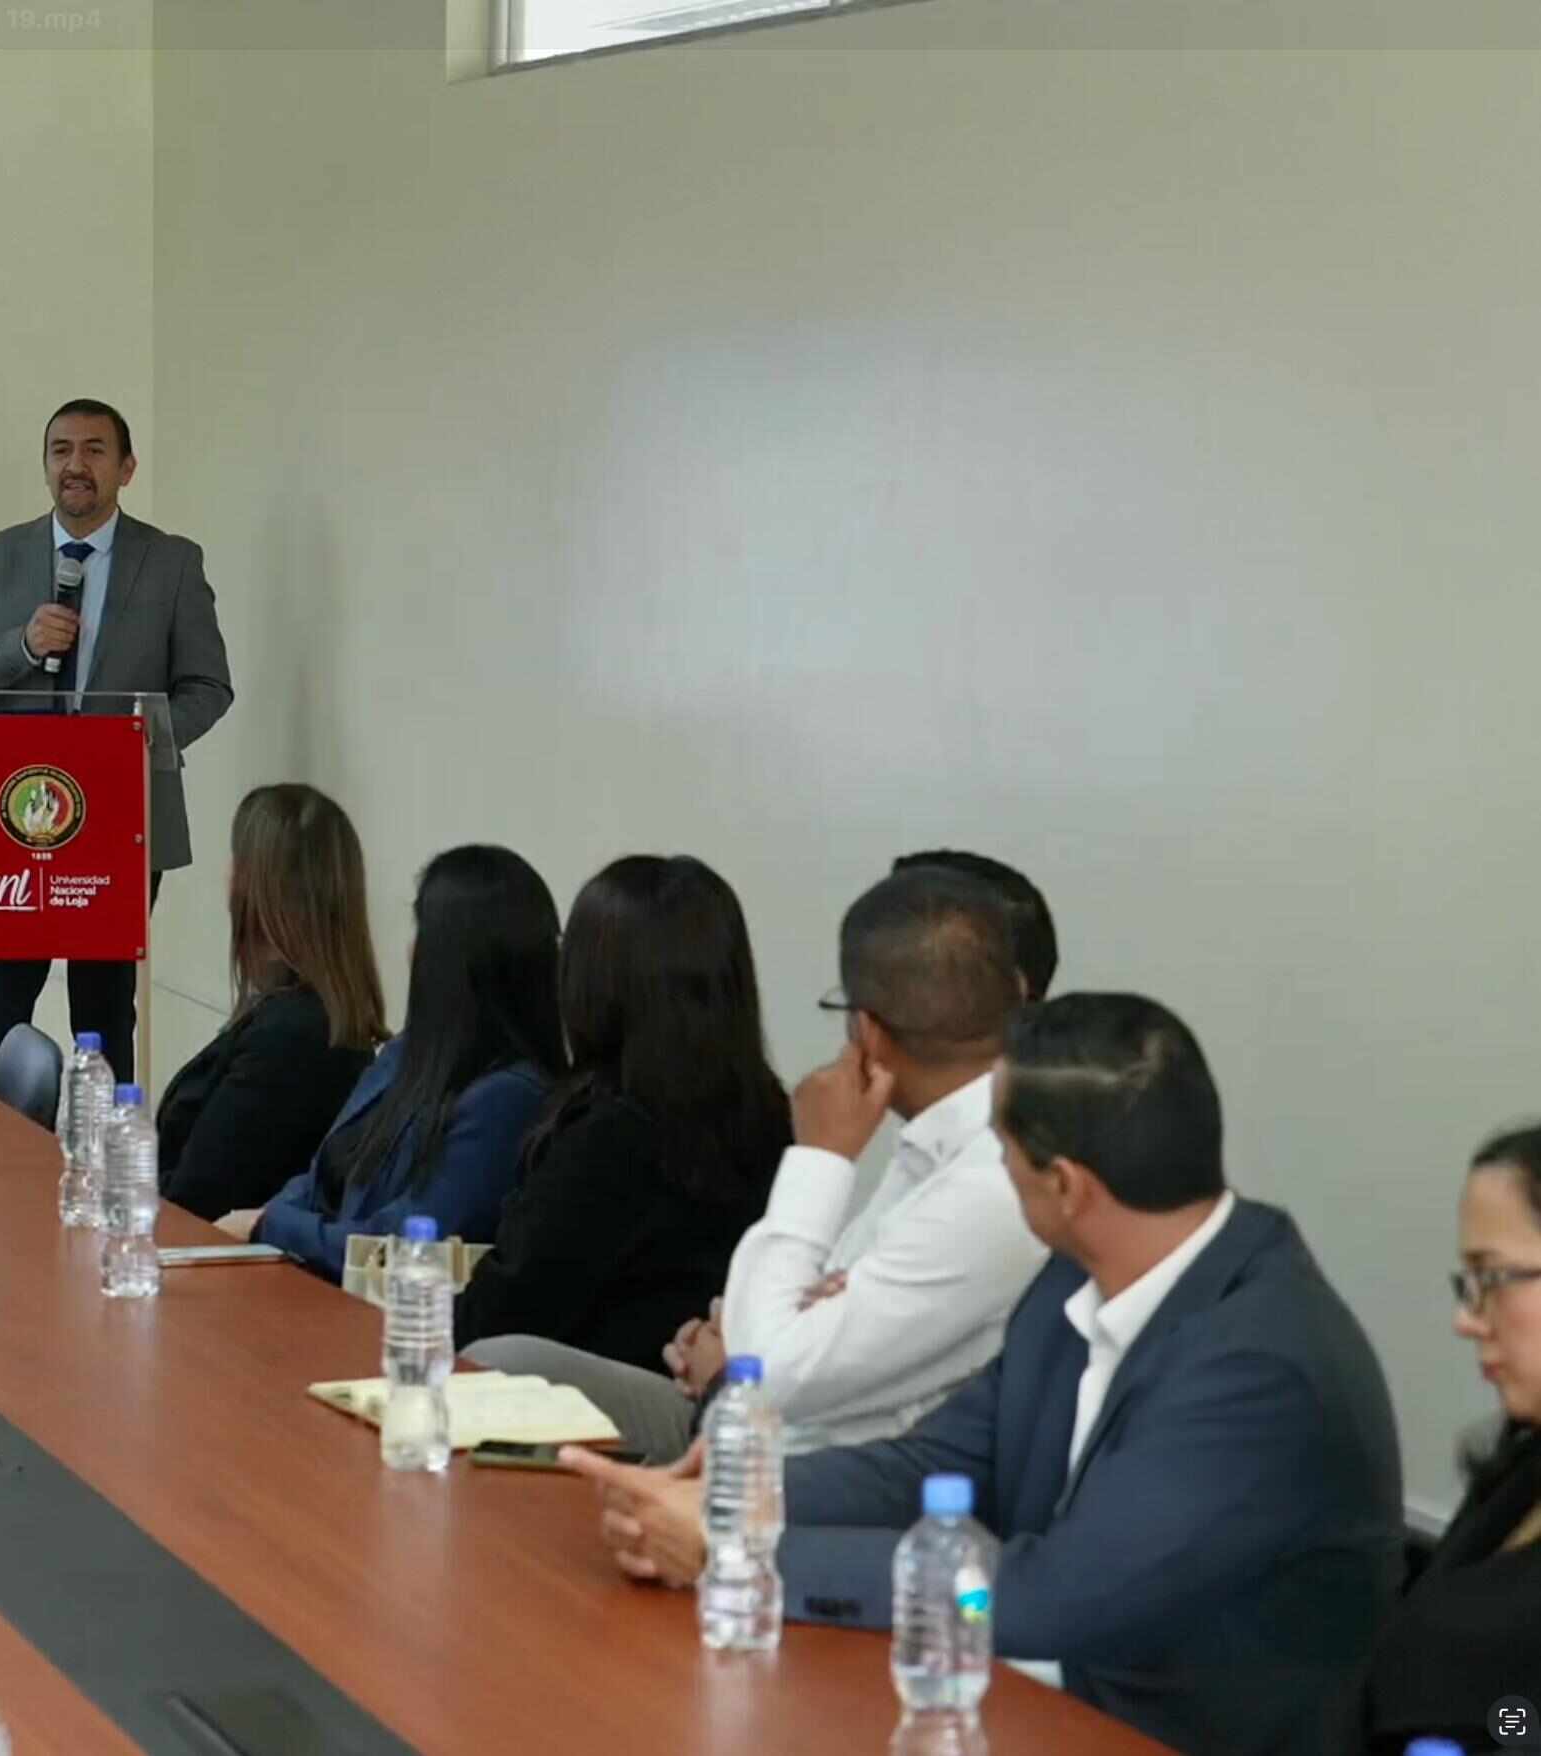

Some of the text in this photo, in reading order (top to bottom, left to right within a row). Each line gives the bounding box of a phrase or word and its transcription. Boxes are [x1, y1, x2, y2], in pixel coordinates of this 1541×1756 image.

[50, 875, 111, 886] Universidad
[50, 886, 96, 896] Nacional
[49, 897, 89, 908] de Loja
